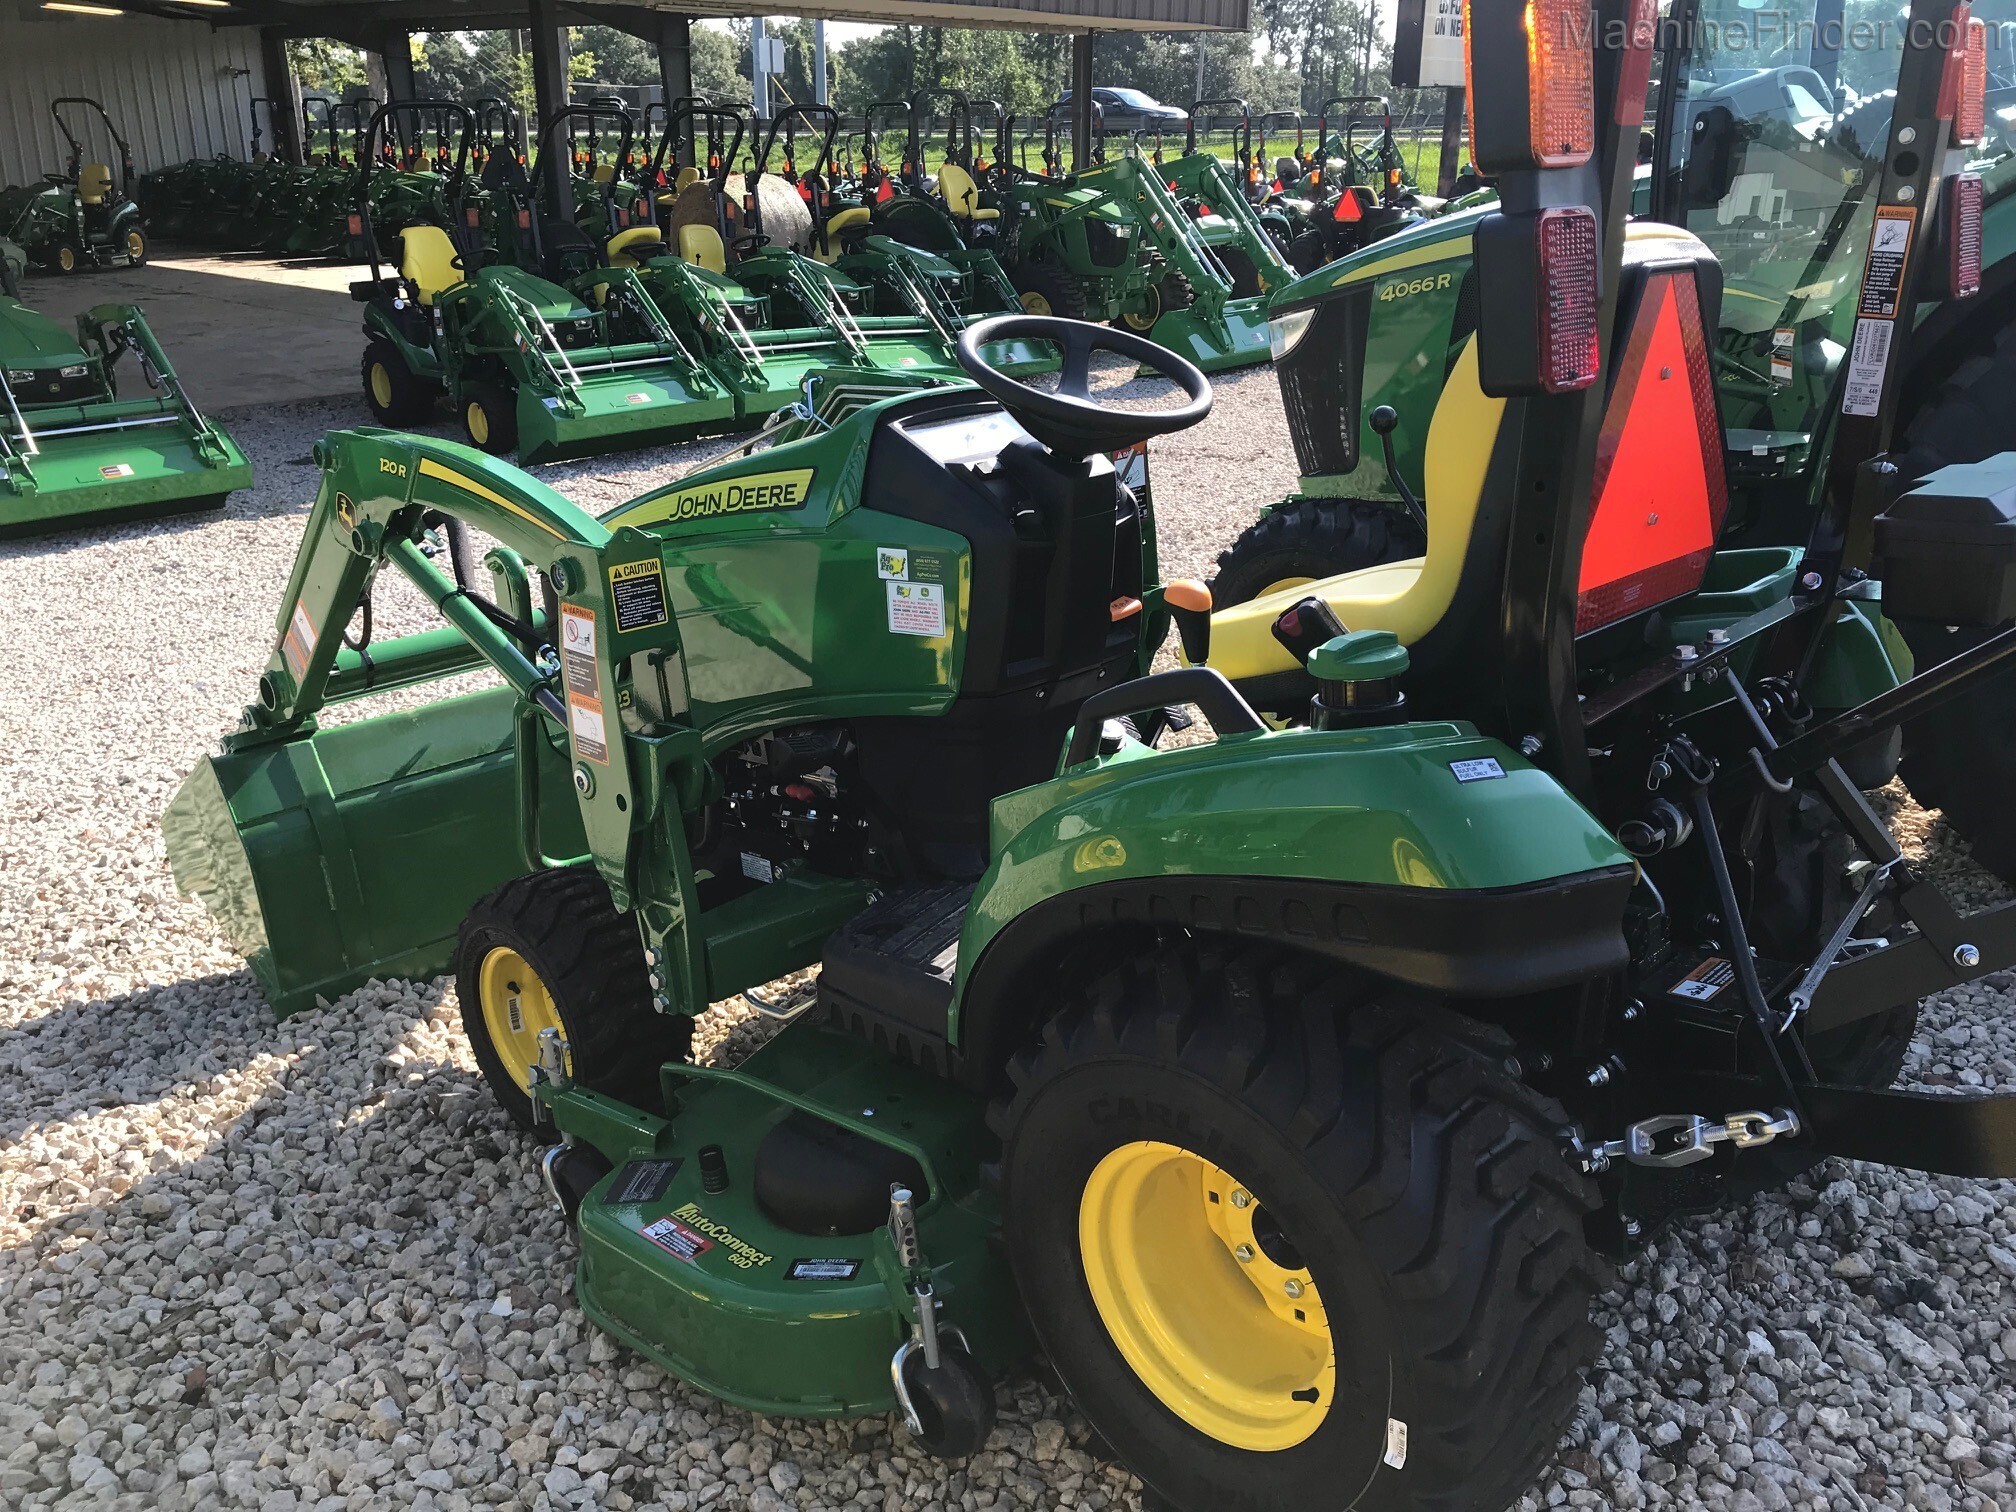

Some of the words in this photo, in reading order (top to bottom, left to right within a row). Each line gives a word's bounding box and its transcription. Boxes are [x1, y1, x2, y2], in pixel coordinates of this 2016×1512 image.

[1434, 18, 1446, 35] ON
[1450, 19, 1464, 37] NE
[1856, 322, 1865, 343] DEERE
[669, 493, 723, 519] JOHN
[726, 483, 798, 509] DEERE
[623, 560, 659, 577] CAUTION
[568, 605, 594, 620] WARNING
[575, 698, 602, 714] WARNING
[676, 1207, 773, 1267] AutoConnect
[686, 1230, 705, 1244] DANGER
[727, 1252, 753, 1270] 60D
